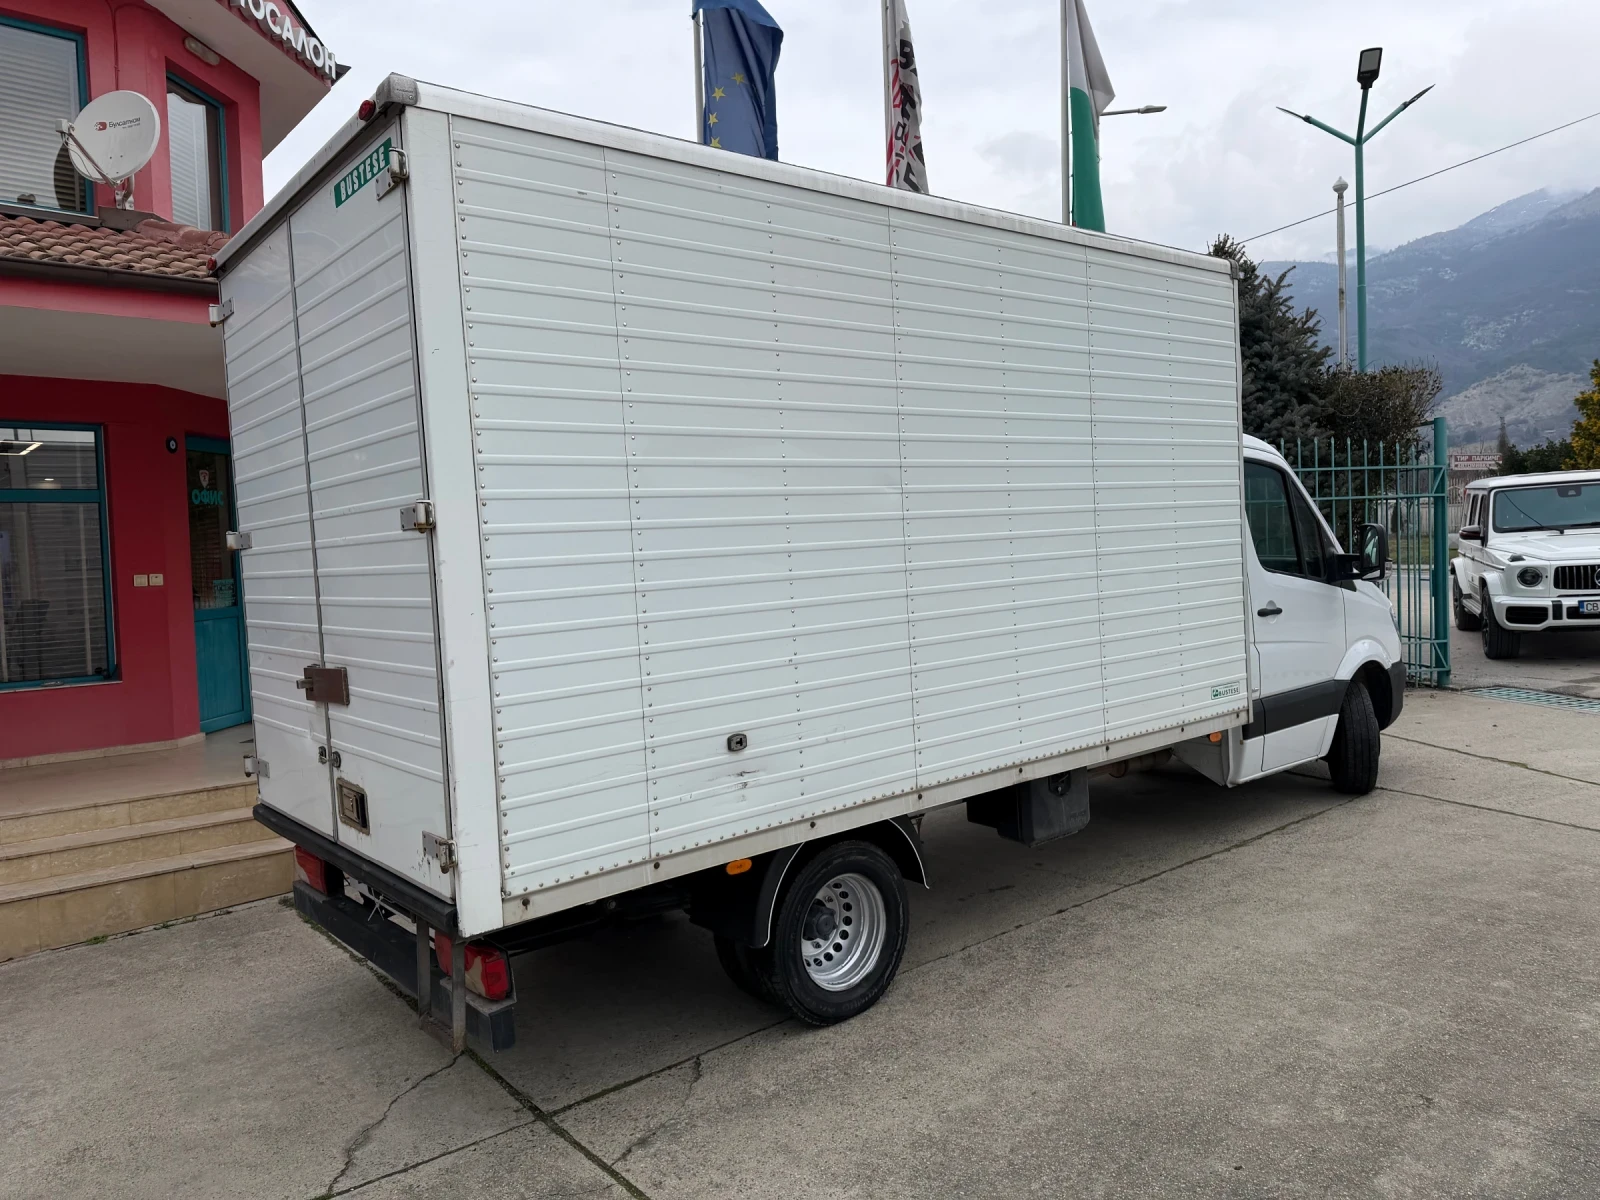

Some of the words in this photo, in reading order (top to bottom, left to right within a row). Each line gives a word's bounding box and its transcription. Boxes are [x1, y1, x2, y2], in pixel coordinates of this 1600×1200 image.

[240, 0, 336, 80] ОСАЛОН
[340, 145, 386, 202] BUSTESE
[191, 488, 225, 507] ОФИС
[1586, 602, 1599, 612] CB
[1219, 687, 1239, 697] BUSTESE
